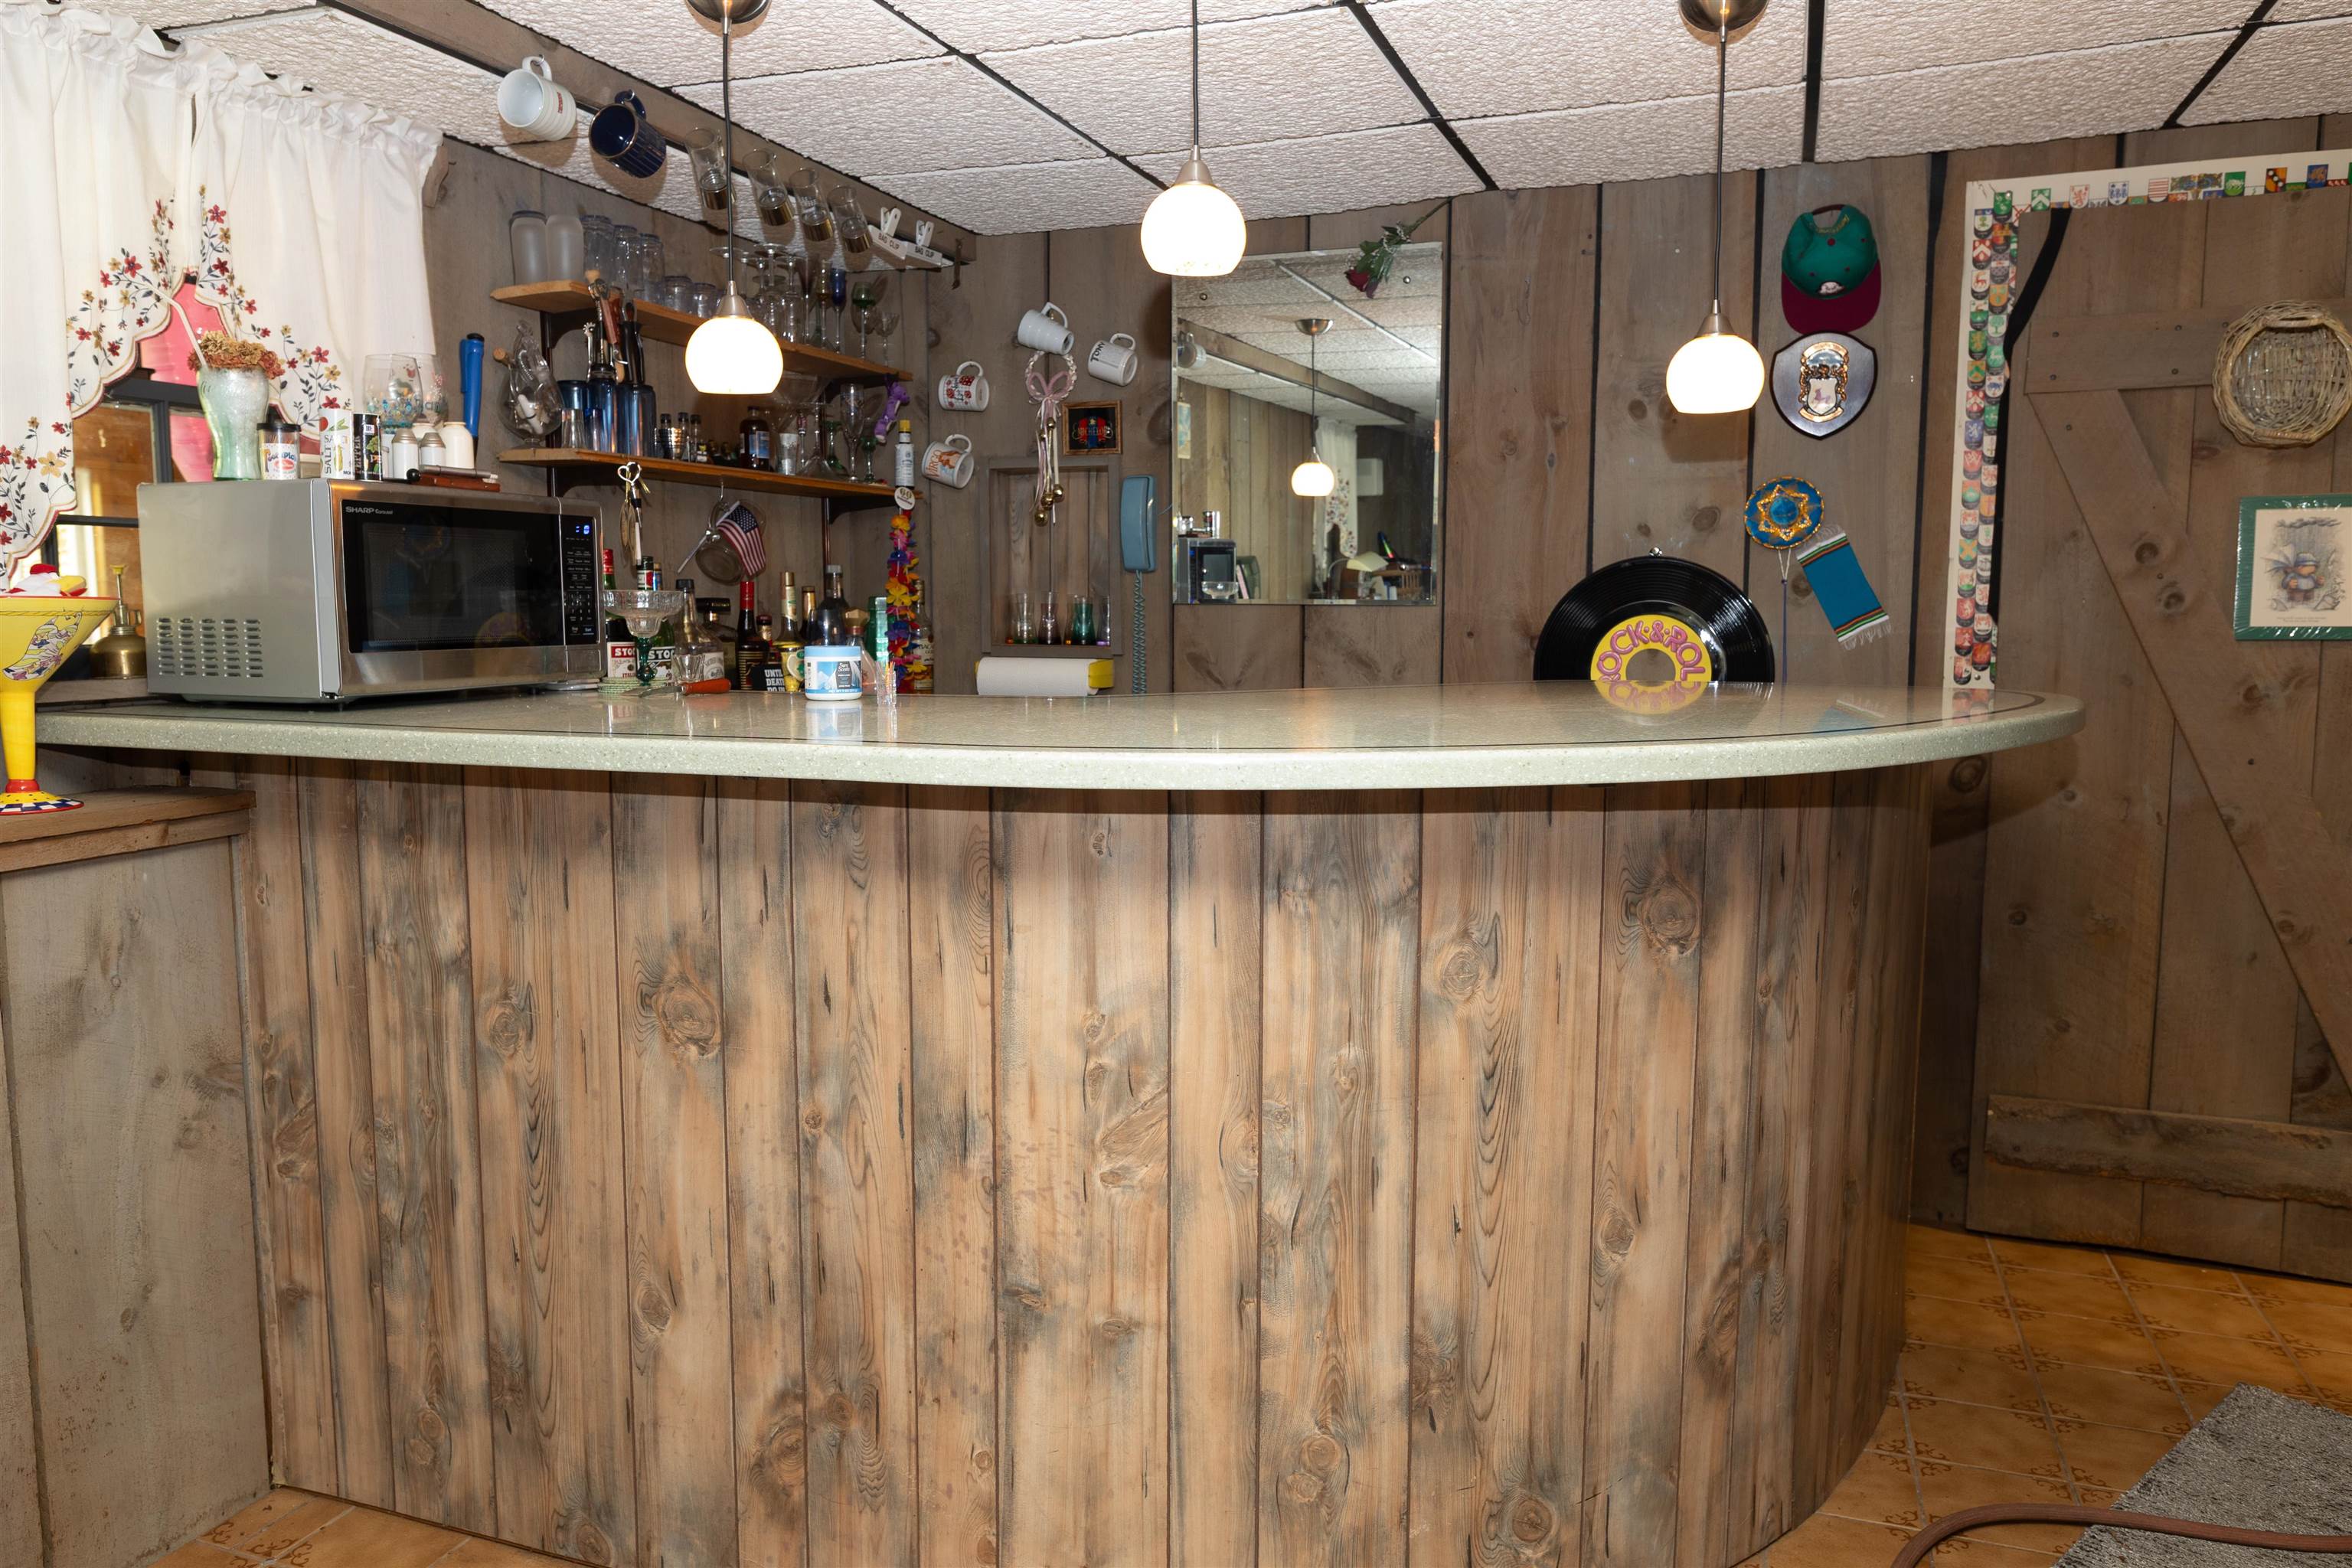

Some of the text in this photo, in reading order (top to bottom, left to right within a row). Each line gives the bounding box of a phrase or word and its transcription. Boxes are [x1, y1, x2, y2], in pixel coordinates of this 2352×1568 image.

[878, 232, 900, 250] BAG CLIP
[915, 245, 934, 259] BAG CLIP
[1090, 341, 1106, 362] TONY
[926, 449, 943, 478] VIRGO
[345, 506, 374, 514] SHARP
[615, 644, 636, 657] STO
[648, 649, 675, 660] STO
[1663, 625, 1706, 681] ROL
[764, 669, 783, 678] UNTIL
